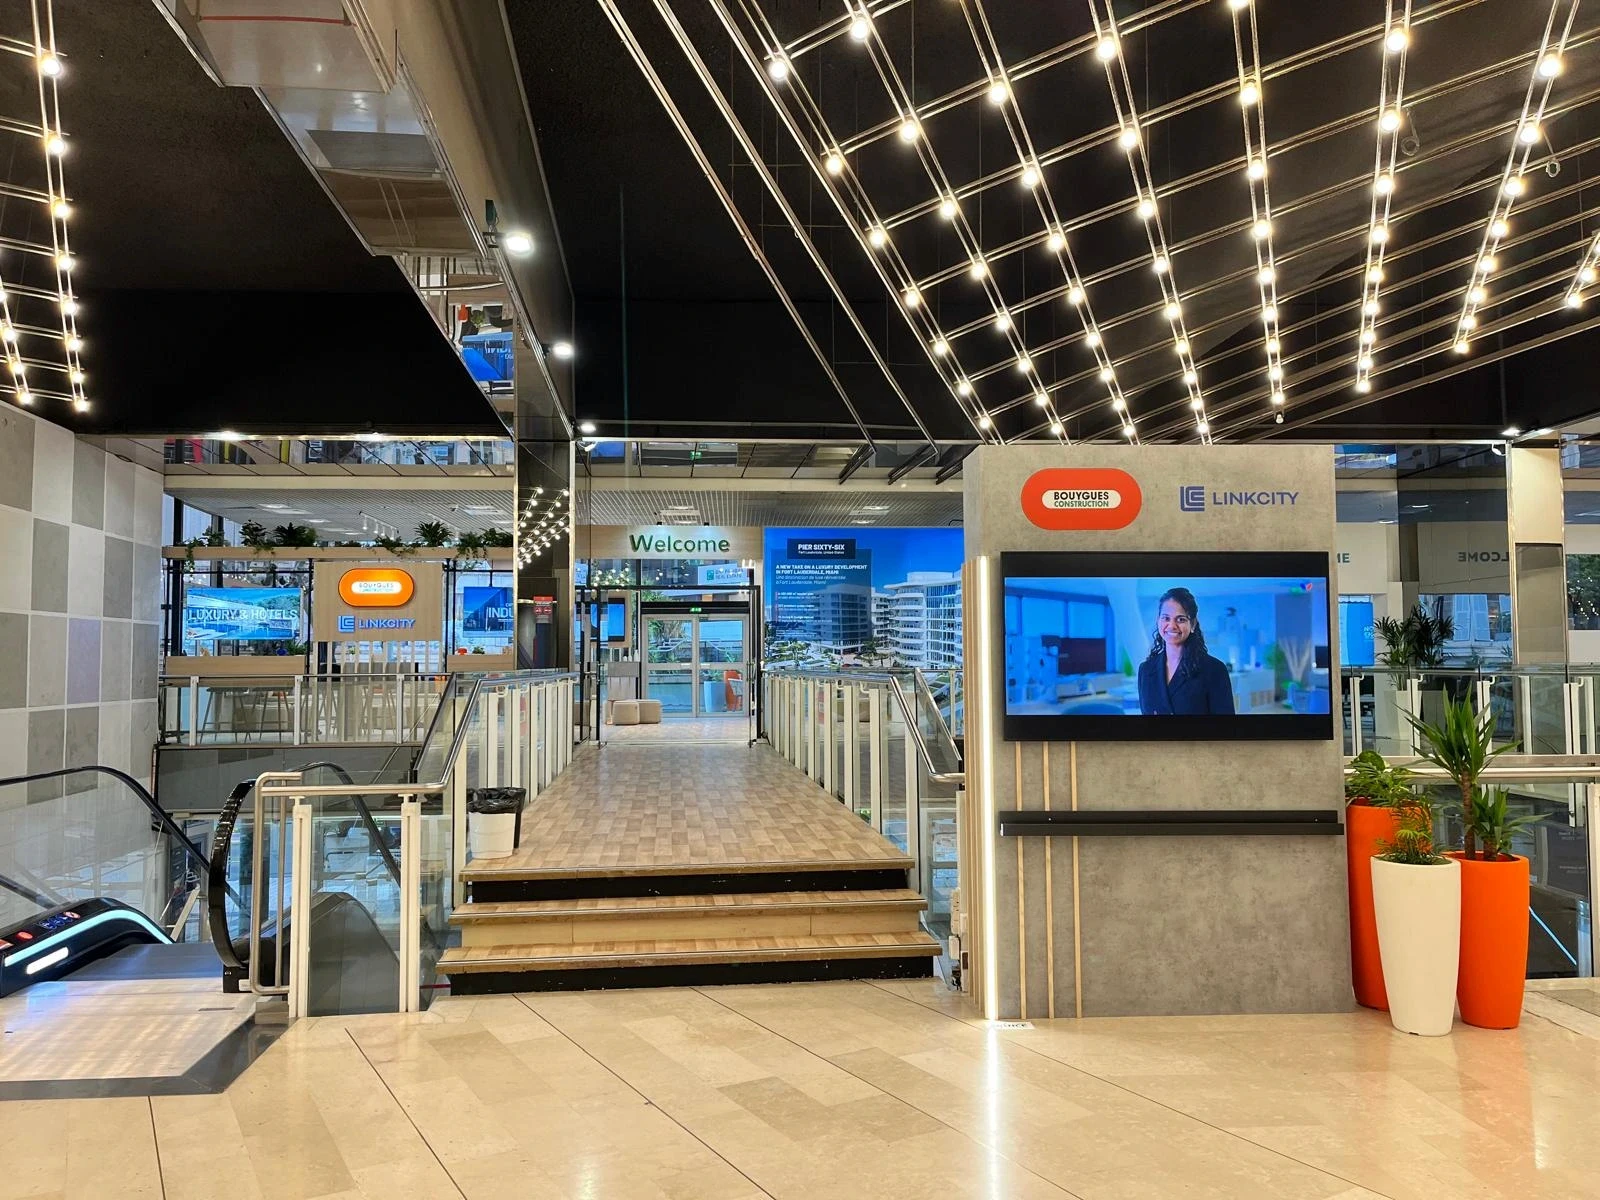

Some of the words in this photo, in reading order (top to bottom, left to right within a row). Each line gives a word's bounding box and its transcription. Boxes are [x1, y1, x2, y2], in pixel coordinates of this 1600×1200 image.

[1053, 491, 1109, 500] BOUYGUES
[1212, 491, 1299, 505] LINKCITY
[629, 534, 730, 552] Welcome
[188, 610, 238, 620] LUXURY
[240, 610, 249, 620] &
[250, 609, 298, 620] HOTELS
[358, 618, 416, 629] LINKCITY
